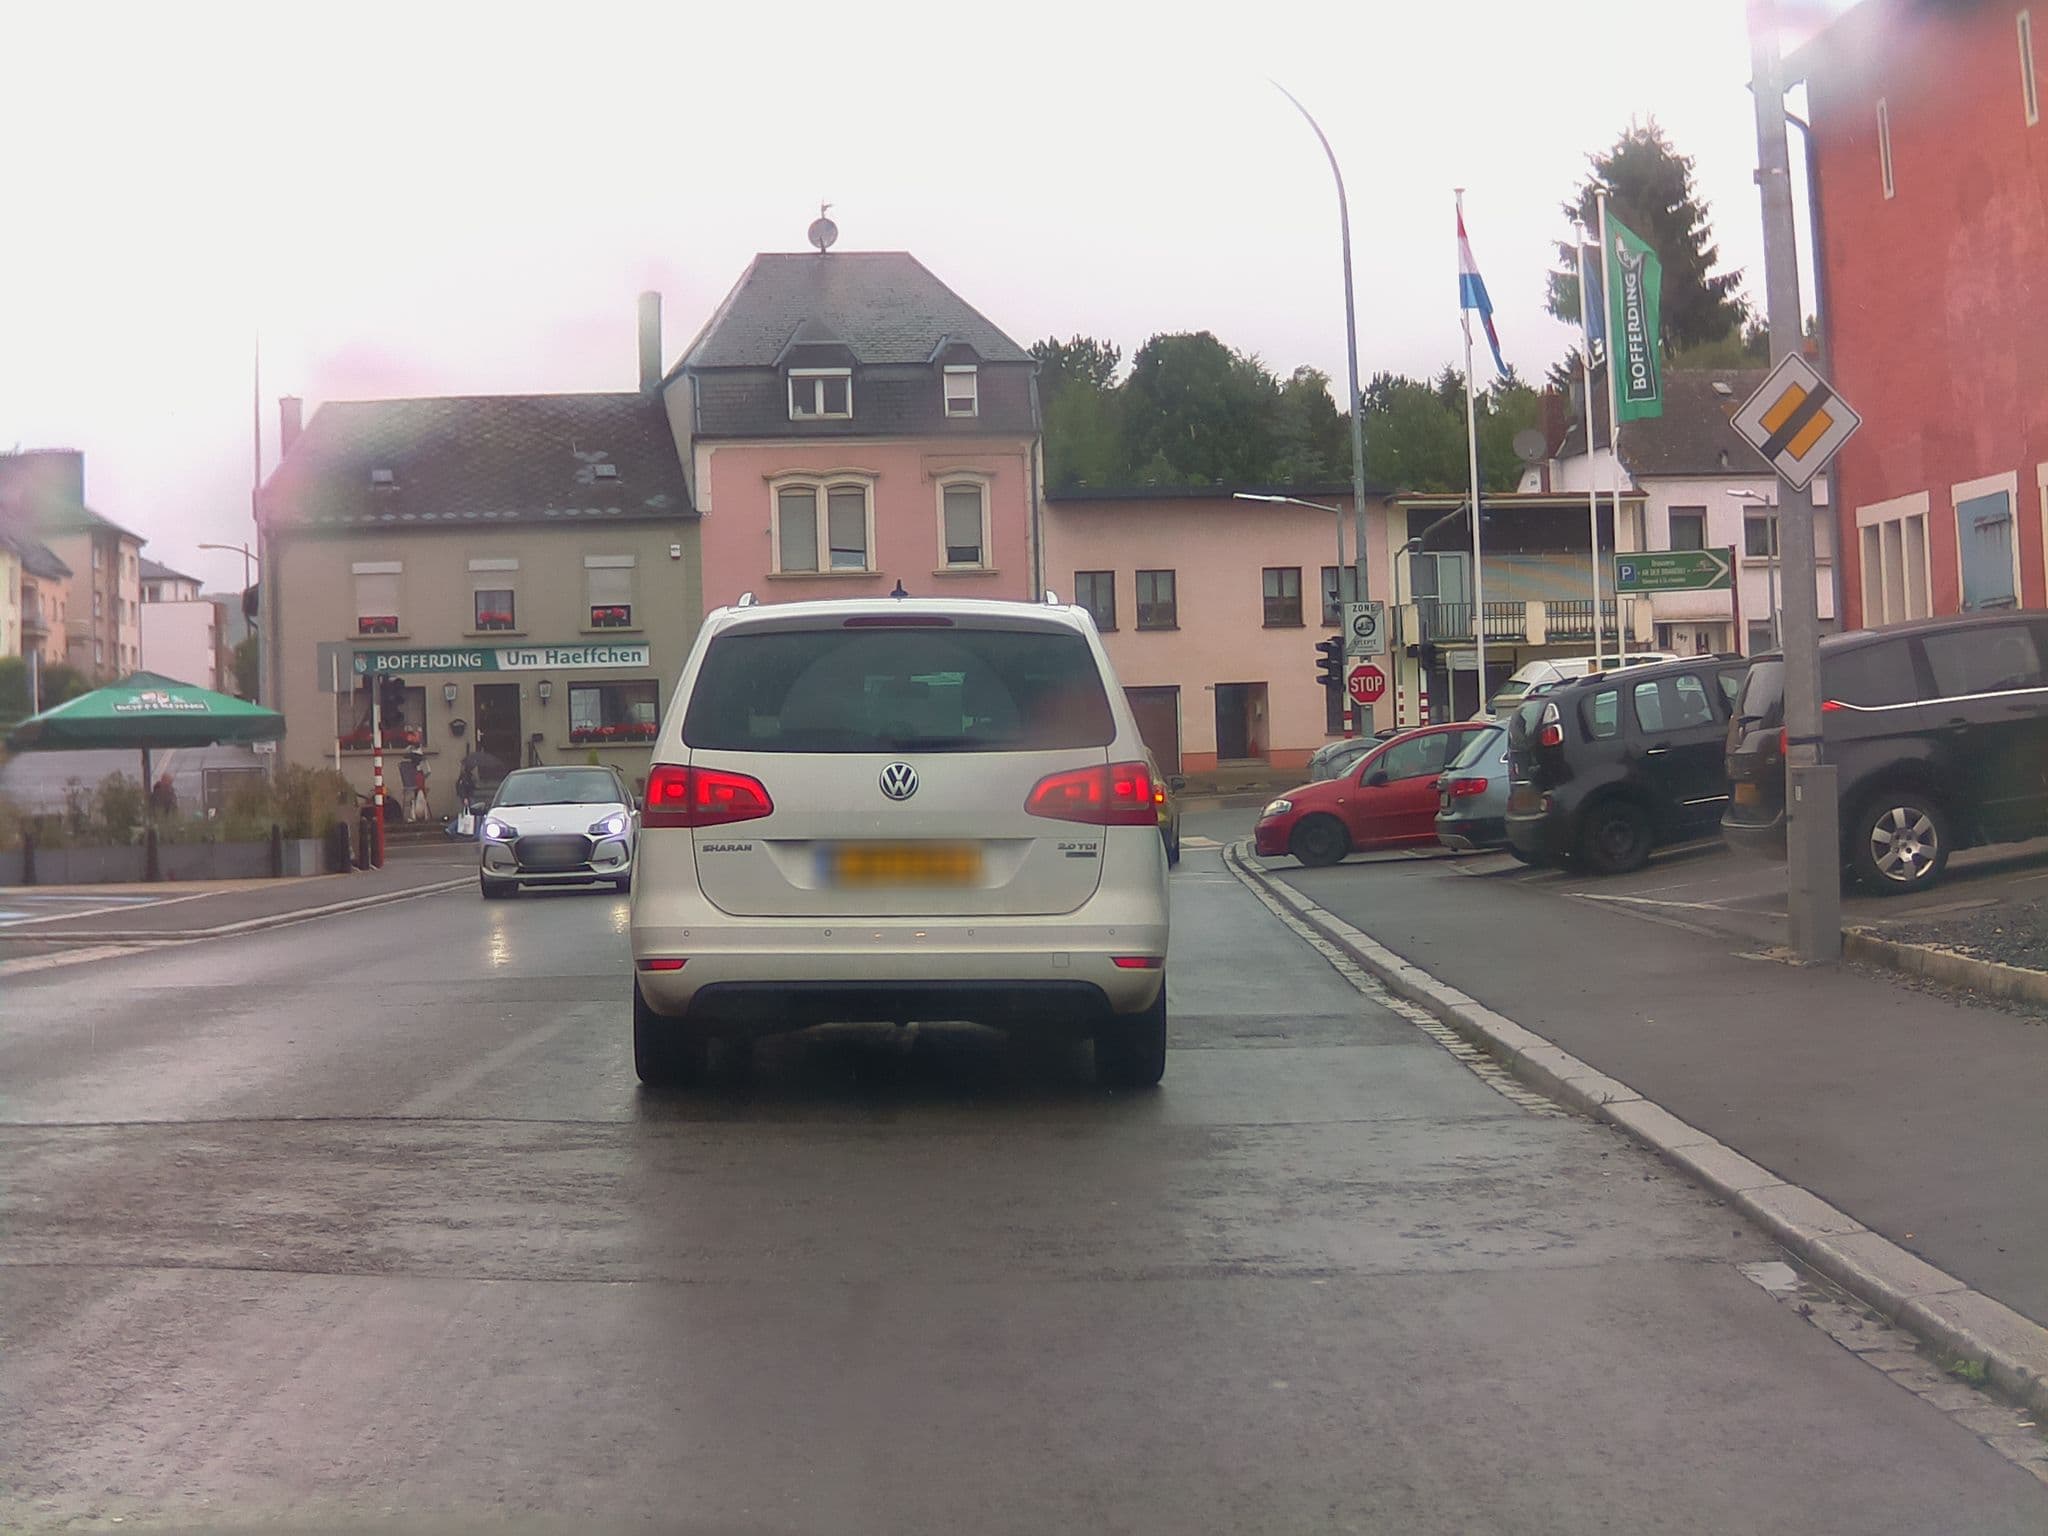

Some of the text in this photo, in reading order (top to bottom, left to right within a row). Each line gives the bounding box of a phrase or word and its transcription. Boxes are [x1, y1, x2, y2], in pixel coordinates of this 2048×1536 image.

[1624, 272, 1647, 391] BOFFERDING
[1621, 566, 1632, 580] P
[1352, 604, 1376, 613] ZONE
[377, 647, 642, 670] BOFFERDING Um Haeffchen
[1350, 676, 1383, 693] STOP
[702, 844, 752, 852] SHARAN
